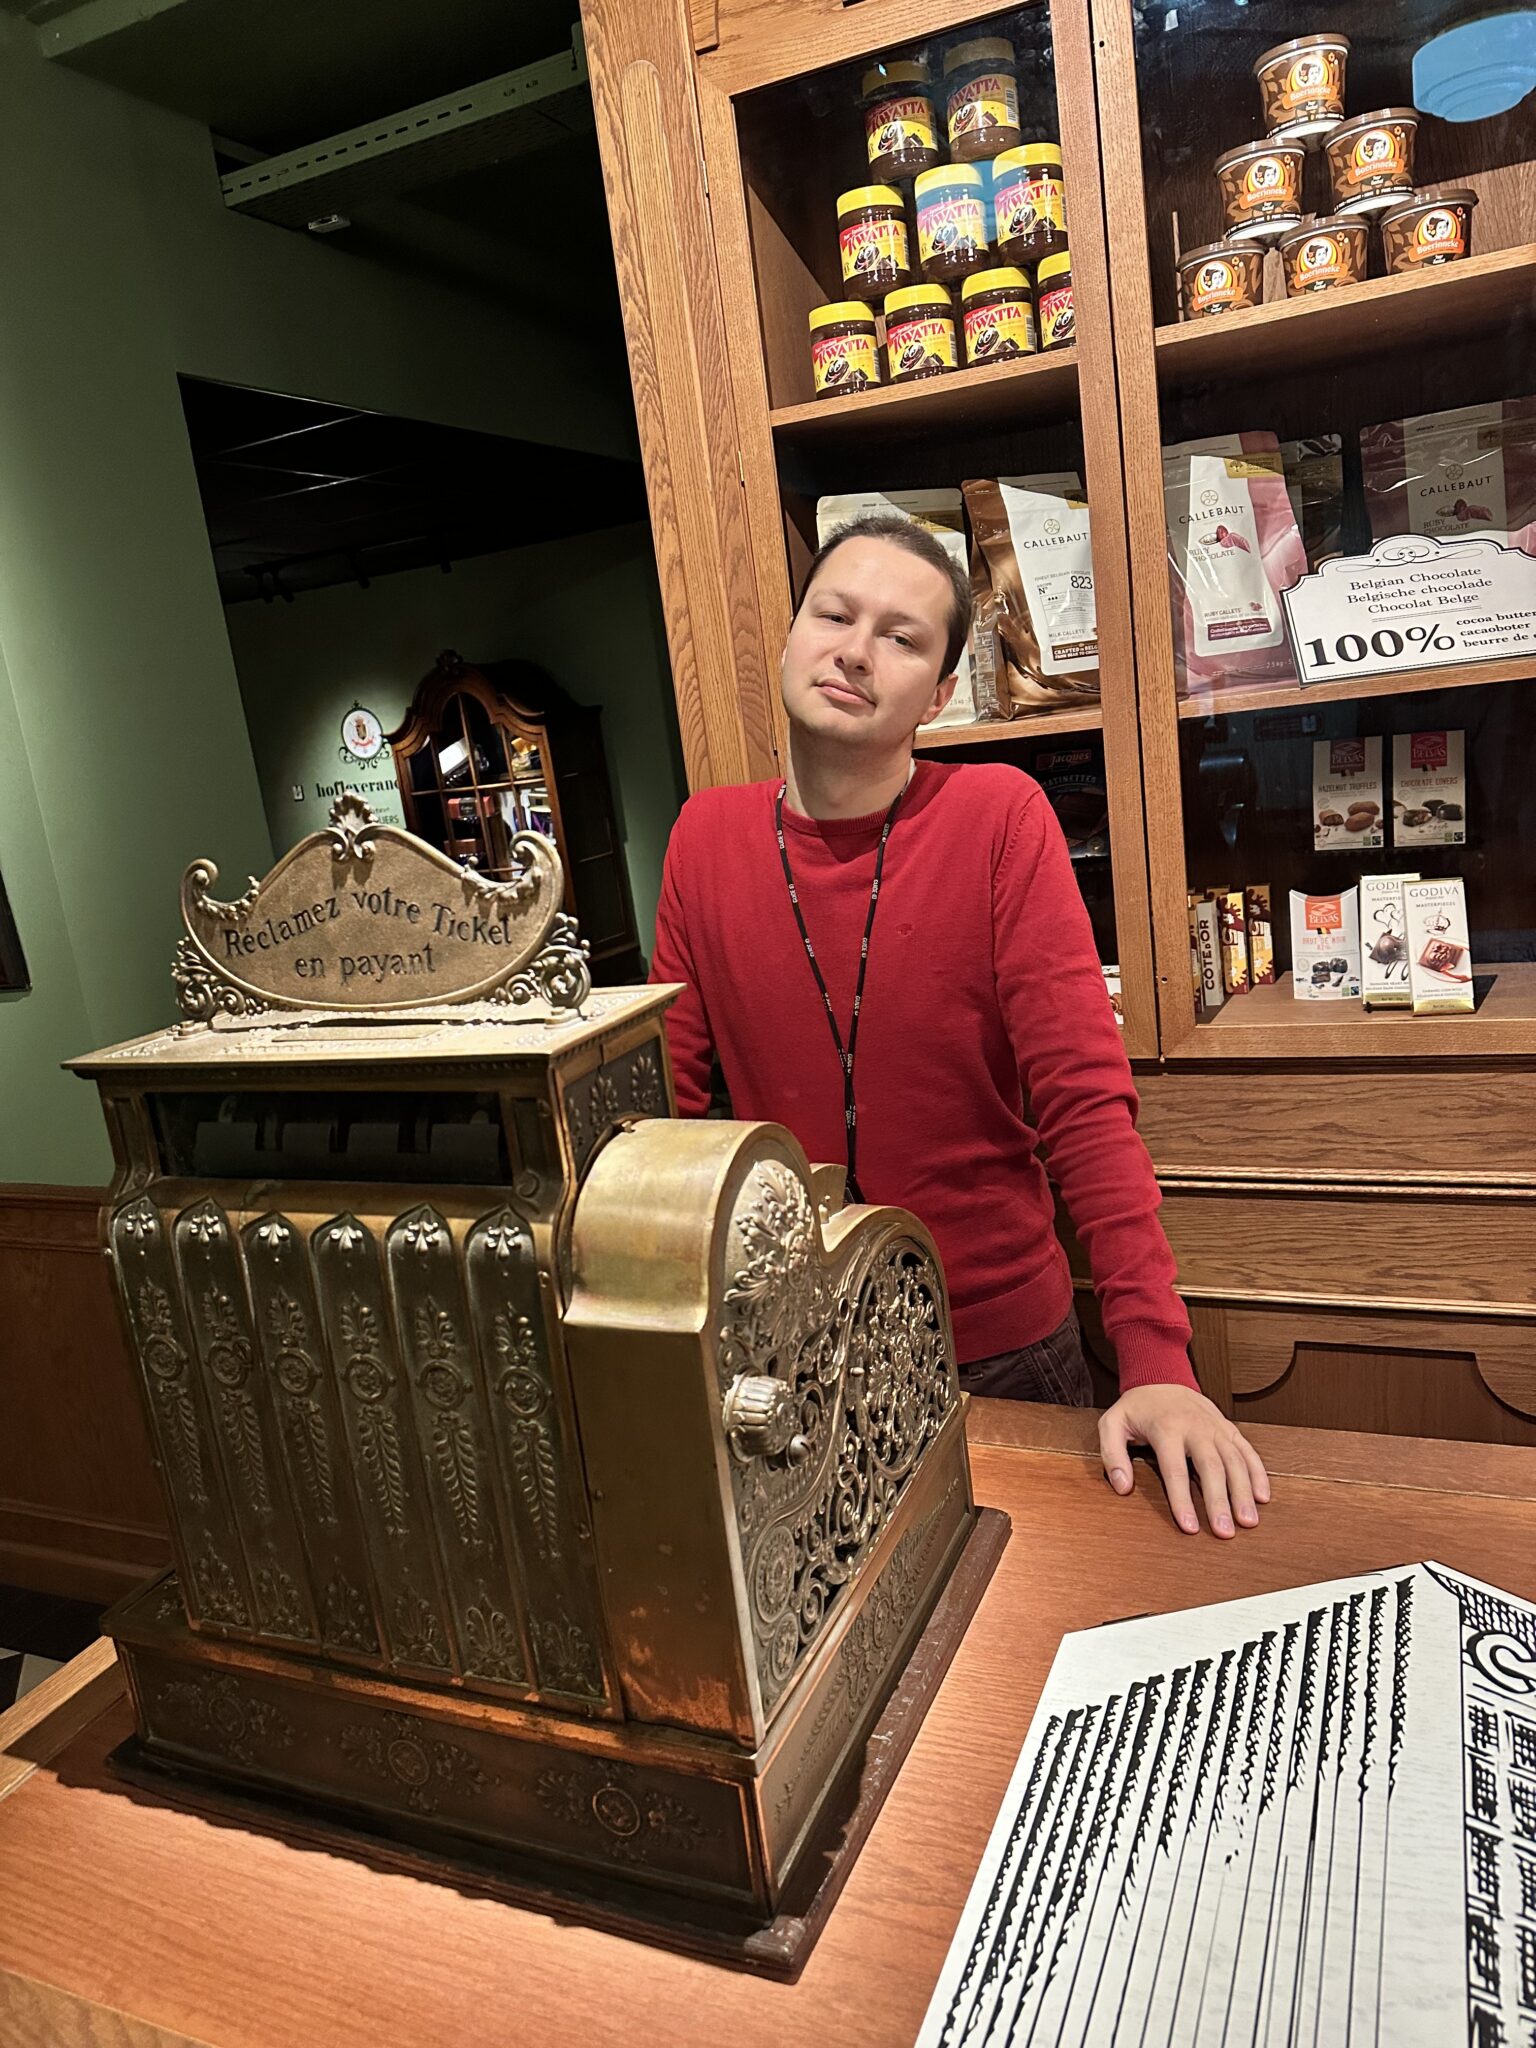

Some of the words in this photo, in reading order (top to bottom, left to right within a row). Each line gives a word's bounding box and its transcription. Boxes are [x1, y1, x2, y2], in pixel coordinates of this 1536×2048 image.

[870, 100, 926, 138] KWATTA
[1001, 184, 1058, 217] KWATTA
[923, 203, 979, 237] KWATTA
[847, 225, 900, 256] KWATTA
[967, 306, 1022, 340] KWATTA
[892, 322, 946, 355] KWATTA
[816, 338, 869, 369] KWATTA
[1420, 475, 1492, 497] CALLEBAUT
[1178, 505, 1245, 525] CALLEBAUT
[1023, 532, 1089, 549] CALLEBAUT
[1070, 575, 1093, 590] 823
[1347, 588, 1417, 604] Belgische
[1421, 578, 1494, 595] chocolade
[1350, 577, 1404, 591] Belgian
[1409, 567, 1483, 583] Chocolate
[1368, 598, 1433, 614] Chocolat
[1438, 593, 1481, 606] Belge
[1456, 616, 1493, 625] cocoa
[1495, 611, 1536, 621] butter
[1460, 622, 1531, 637] cacaoboter
[1305, 623, 1456, 668] 100%
[1463, 637, 1509, 648] beurre
[1513, 633, 1529, 641] de
[1366, 881, 1400, 891] GODI
[1409, 886, 1459, 897] GODIVA
[224, 896, 341, 957] Réclamez
[351, 886, 421, 924] votre
[431, 902, 513, 946] Ticket
[294, 957, 326, 979] en
[339, 942, 437, 985] payant
